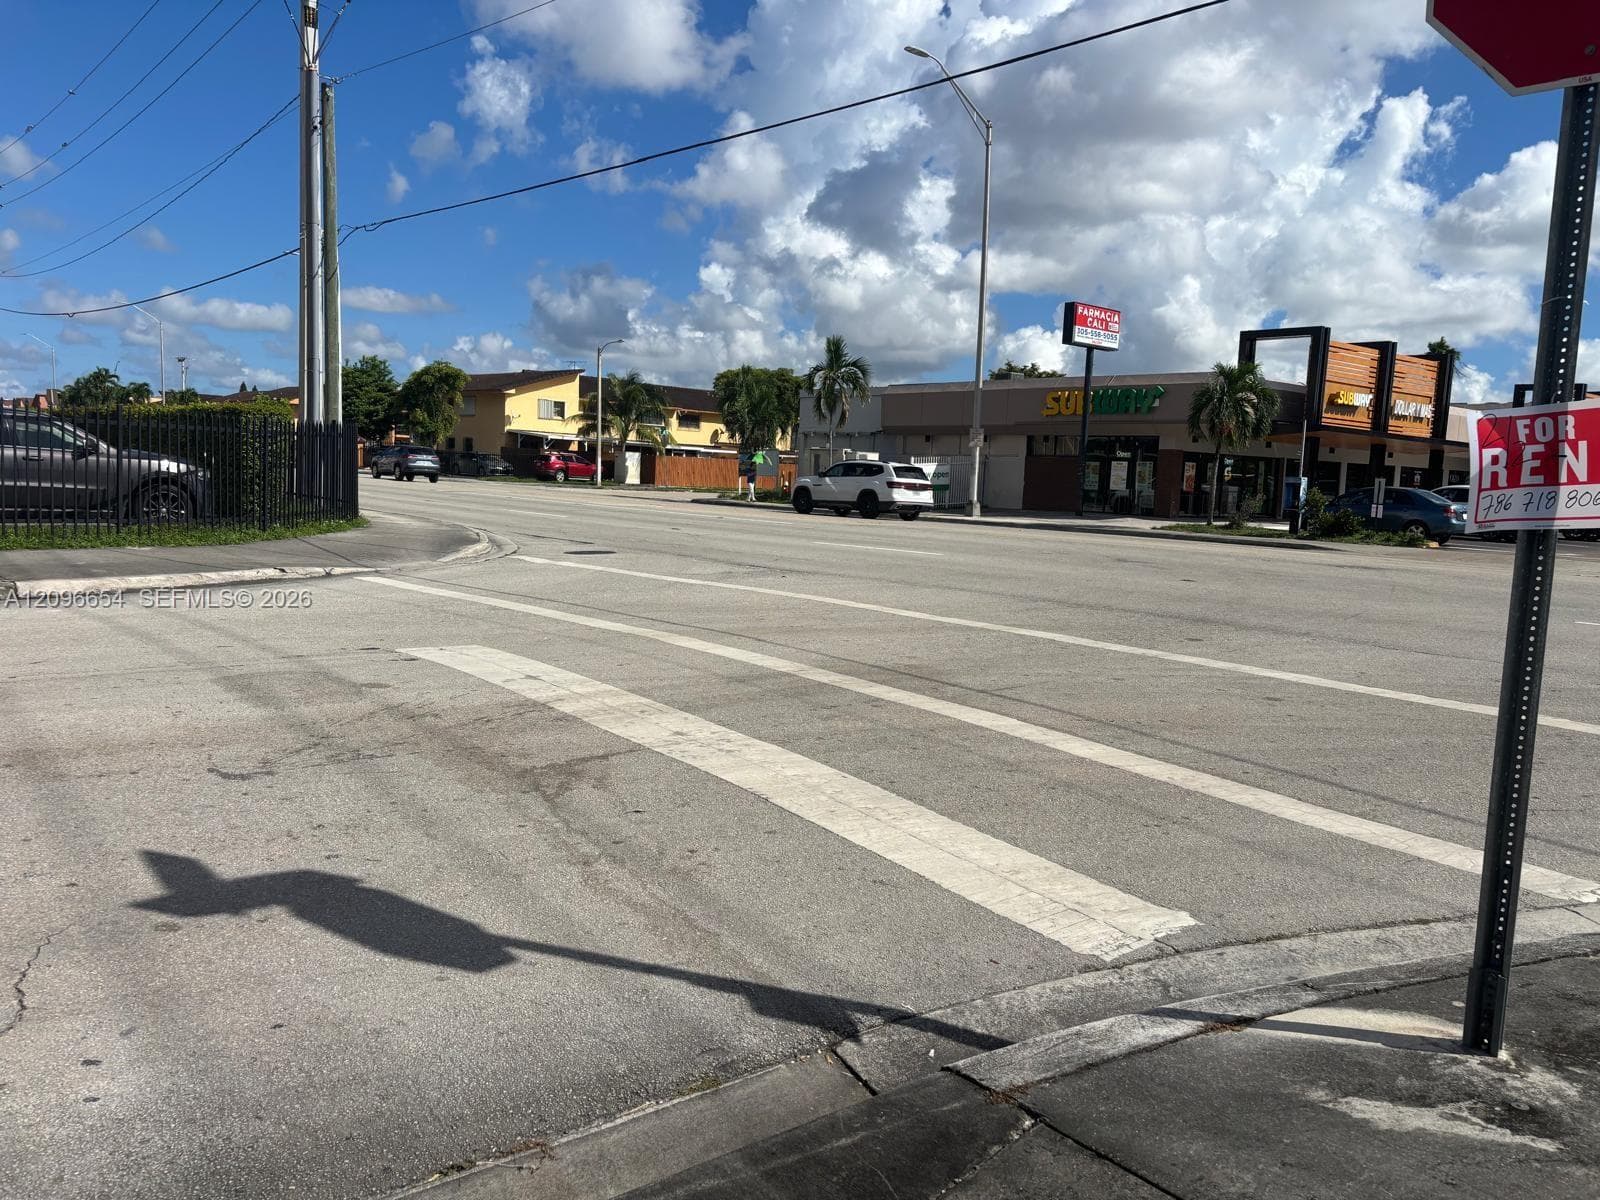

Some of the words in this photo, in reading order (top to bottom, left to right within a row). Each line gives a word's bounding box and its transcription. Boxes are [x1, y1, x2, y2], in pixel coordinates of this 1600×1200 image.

[1578, 75, 1592, 83] USA
[1078, 305, 1119, 324] FARMACIA
[1087, 317, 1105, 330] CALI
[1336, 390, 1374, 408] SUBWAY
[1516, 414, 1576, 443] FOR
[1481, 493, 1513, 519] 786
[1523, 490, 1557, 512] 718
